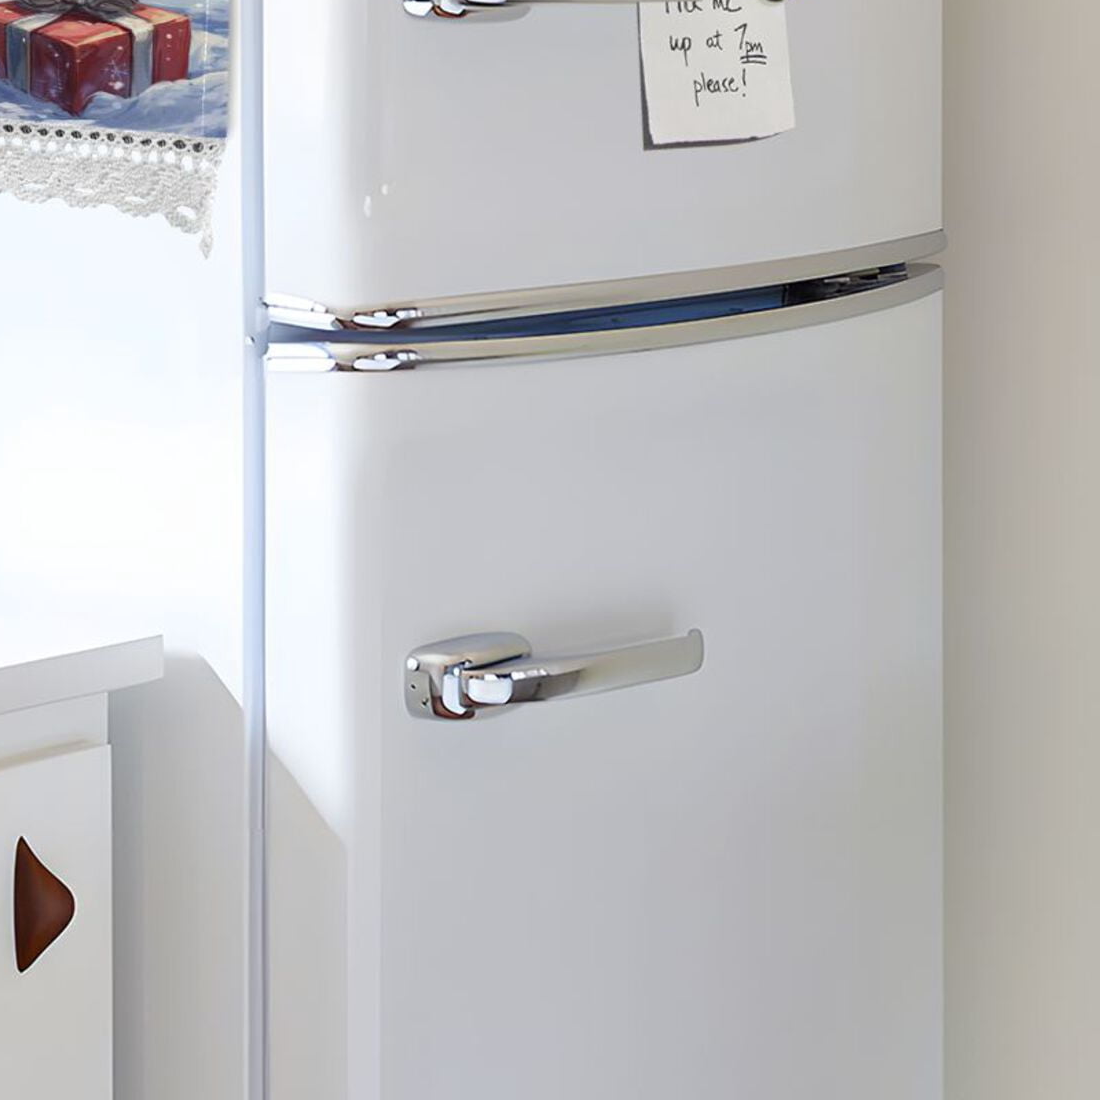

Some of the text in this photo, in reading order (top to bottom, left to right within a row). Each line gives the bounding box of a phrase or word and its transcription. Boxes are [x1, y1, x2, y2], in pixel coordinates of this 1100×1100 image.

[668, 34, 692, 67] up
[705, 29, 723, 51] at
[692, 68, 747, 107] please!
